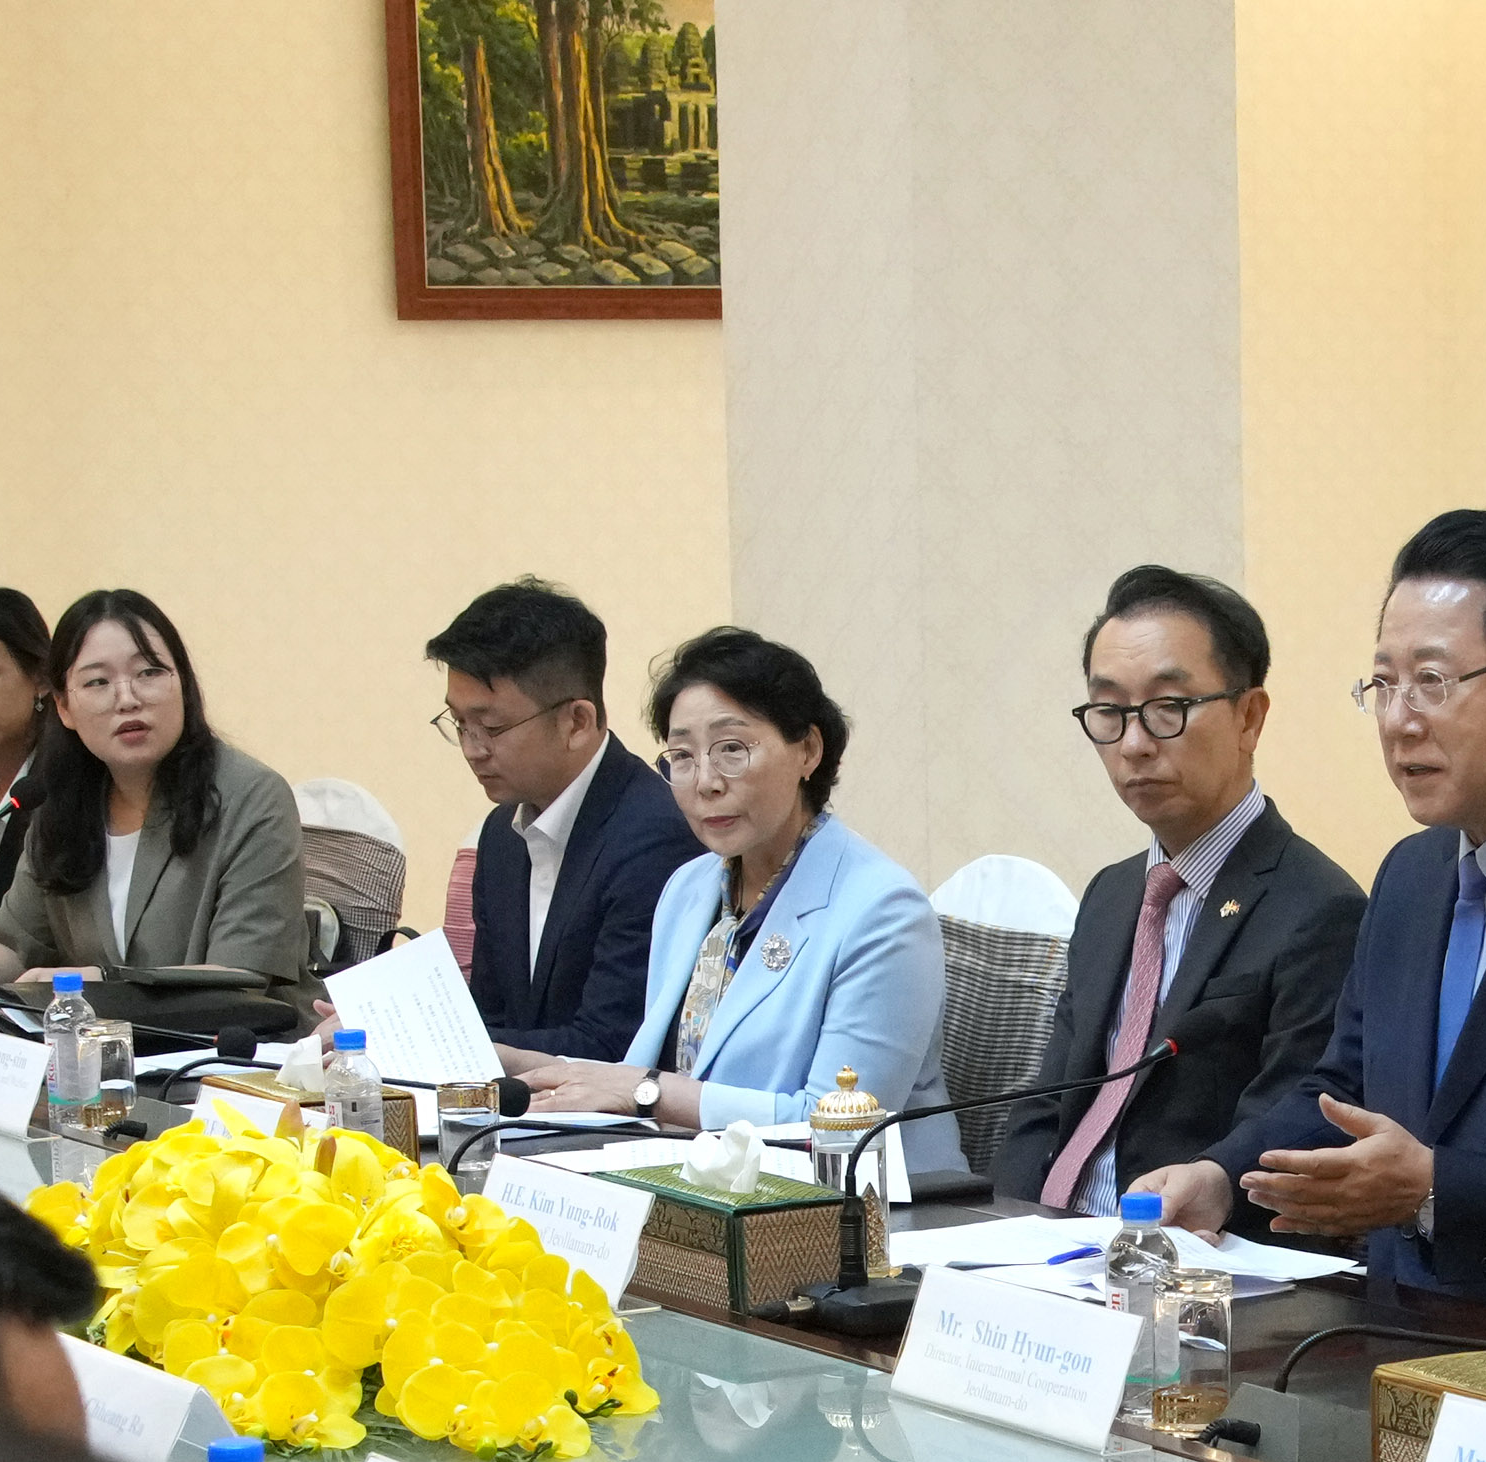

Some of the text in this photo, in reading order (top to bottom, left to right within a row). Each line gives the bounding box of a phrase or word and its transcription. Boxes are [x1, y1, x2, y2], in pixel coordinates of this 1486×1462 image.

[501, 1182, 620, 1232] H.E. Kim Yung-Rok
[547, 1228, 610, 1261] Jeollanam-do
[935, 1310, 1093, 1375] Mr. Shin Hyun-gon
[963, 1380, 1028, 1412] Jeollanam-do
[966, 1353, 1026, 1387] International
[1028, 1371, 1087, 1403] Cooperation
